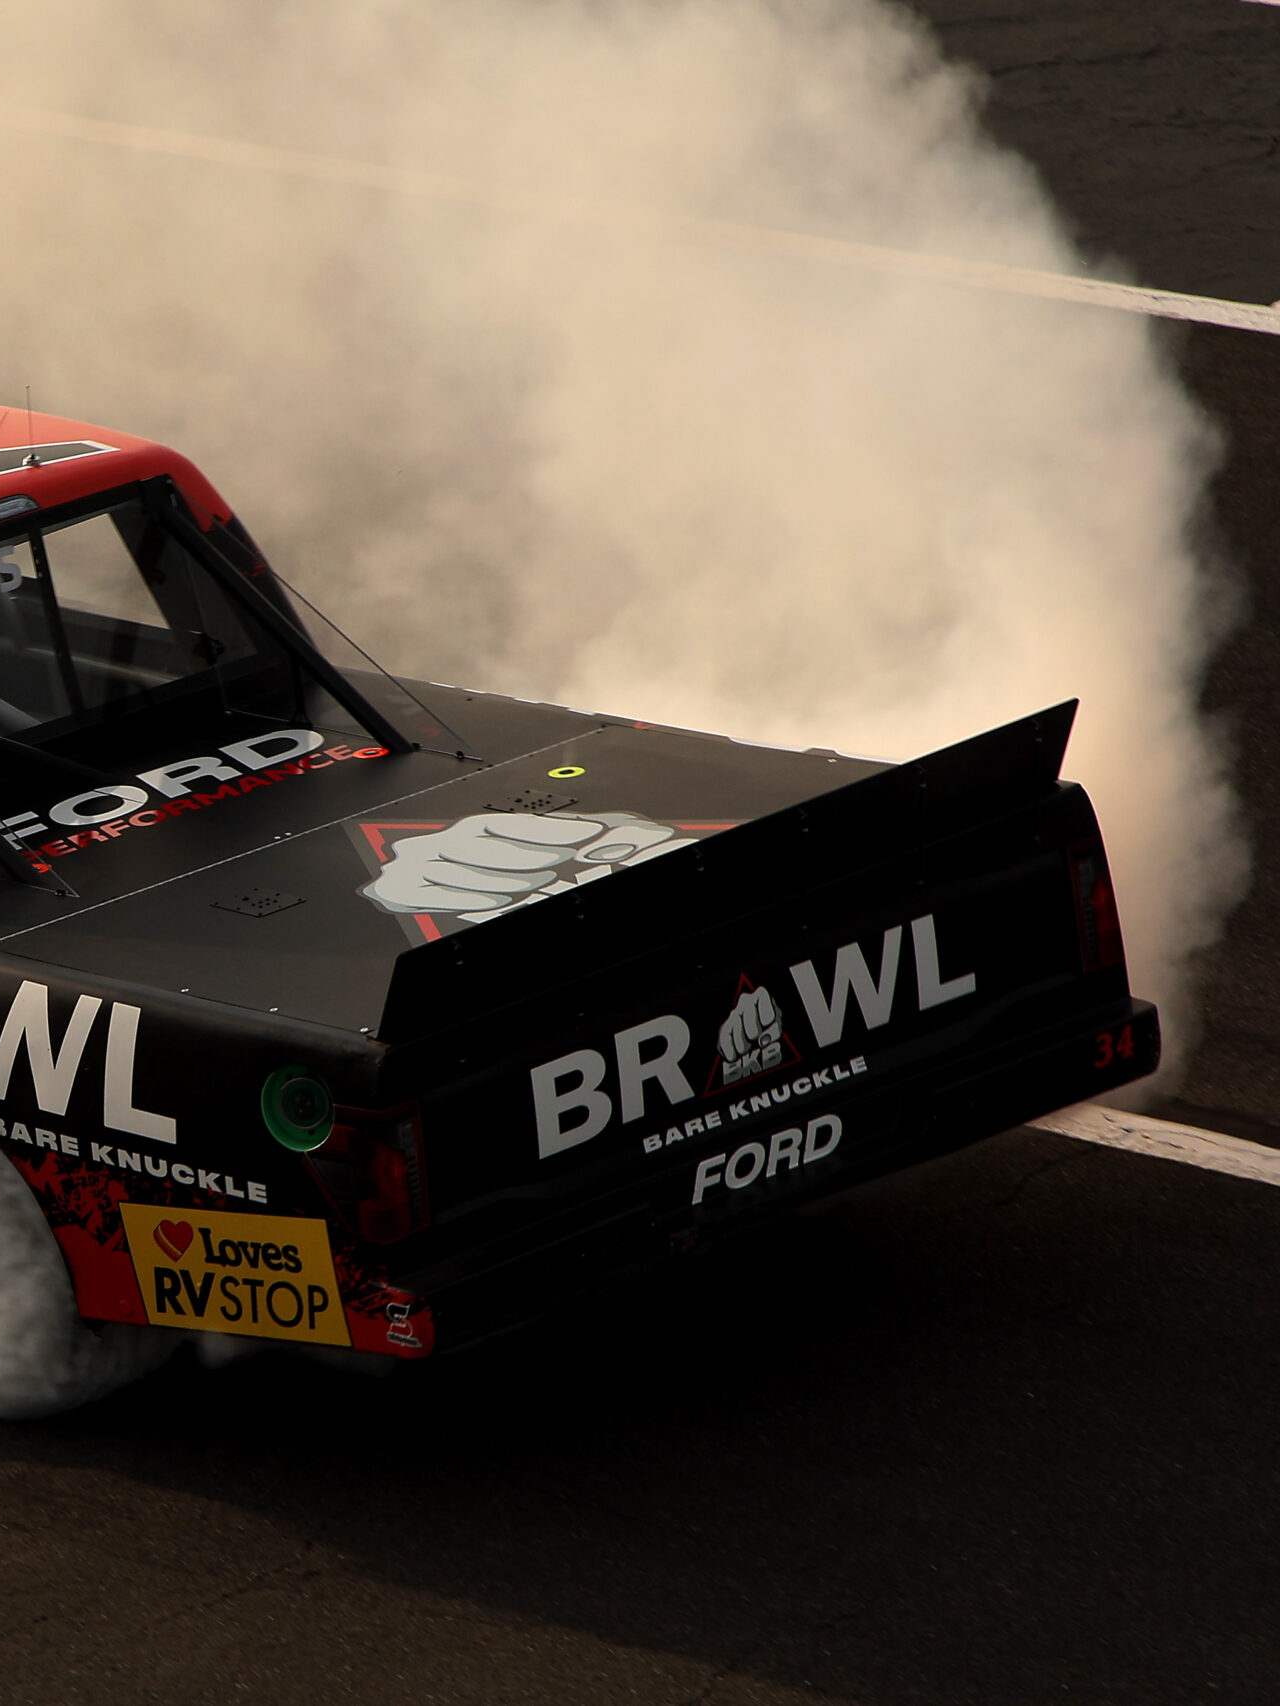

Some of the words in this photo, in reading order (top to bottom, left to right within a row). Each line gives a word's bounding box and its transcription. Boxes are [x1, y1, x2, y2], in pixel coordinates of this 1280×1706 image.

[722, 1041, 783, 1085] BKB
[1094, 1024, 1135, 1069] 34
[642, 1111, 722, 1154] BARE
[729, 1055, 868, 1120] KNUCKLE
[91, 1141, 268, 1204] KNUCKLE
[691, 1113, 843, 1206] FORD
